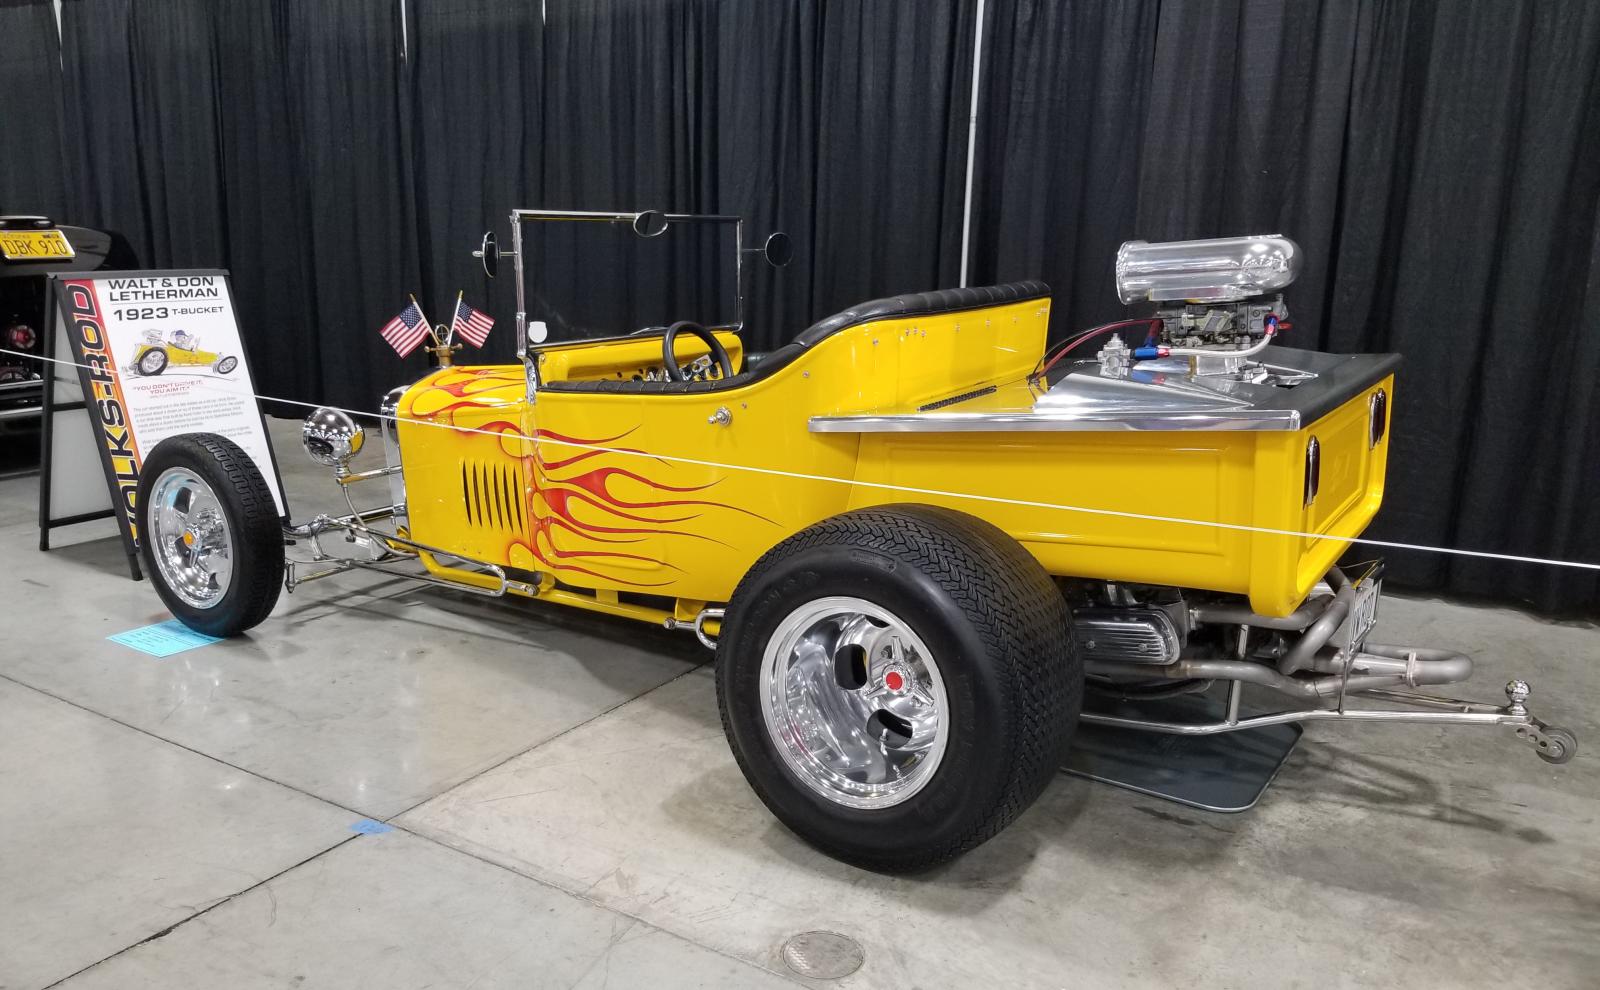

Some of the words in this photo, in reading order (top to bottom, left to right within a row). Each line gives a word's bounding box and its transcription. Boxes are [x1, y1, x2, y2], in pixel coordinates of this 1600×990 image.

[108, 278, 157, 289] WALT
[161, 278, 173, 287] &
[177, 276, 214, 287] DON
[109, 287, 218, 302] LETHERMAN
[113, 307, 169, 321] 1923
[171, 306, 224, 315] T-BUCKET
[66, 283, 140, 548] OLKS-ROD
